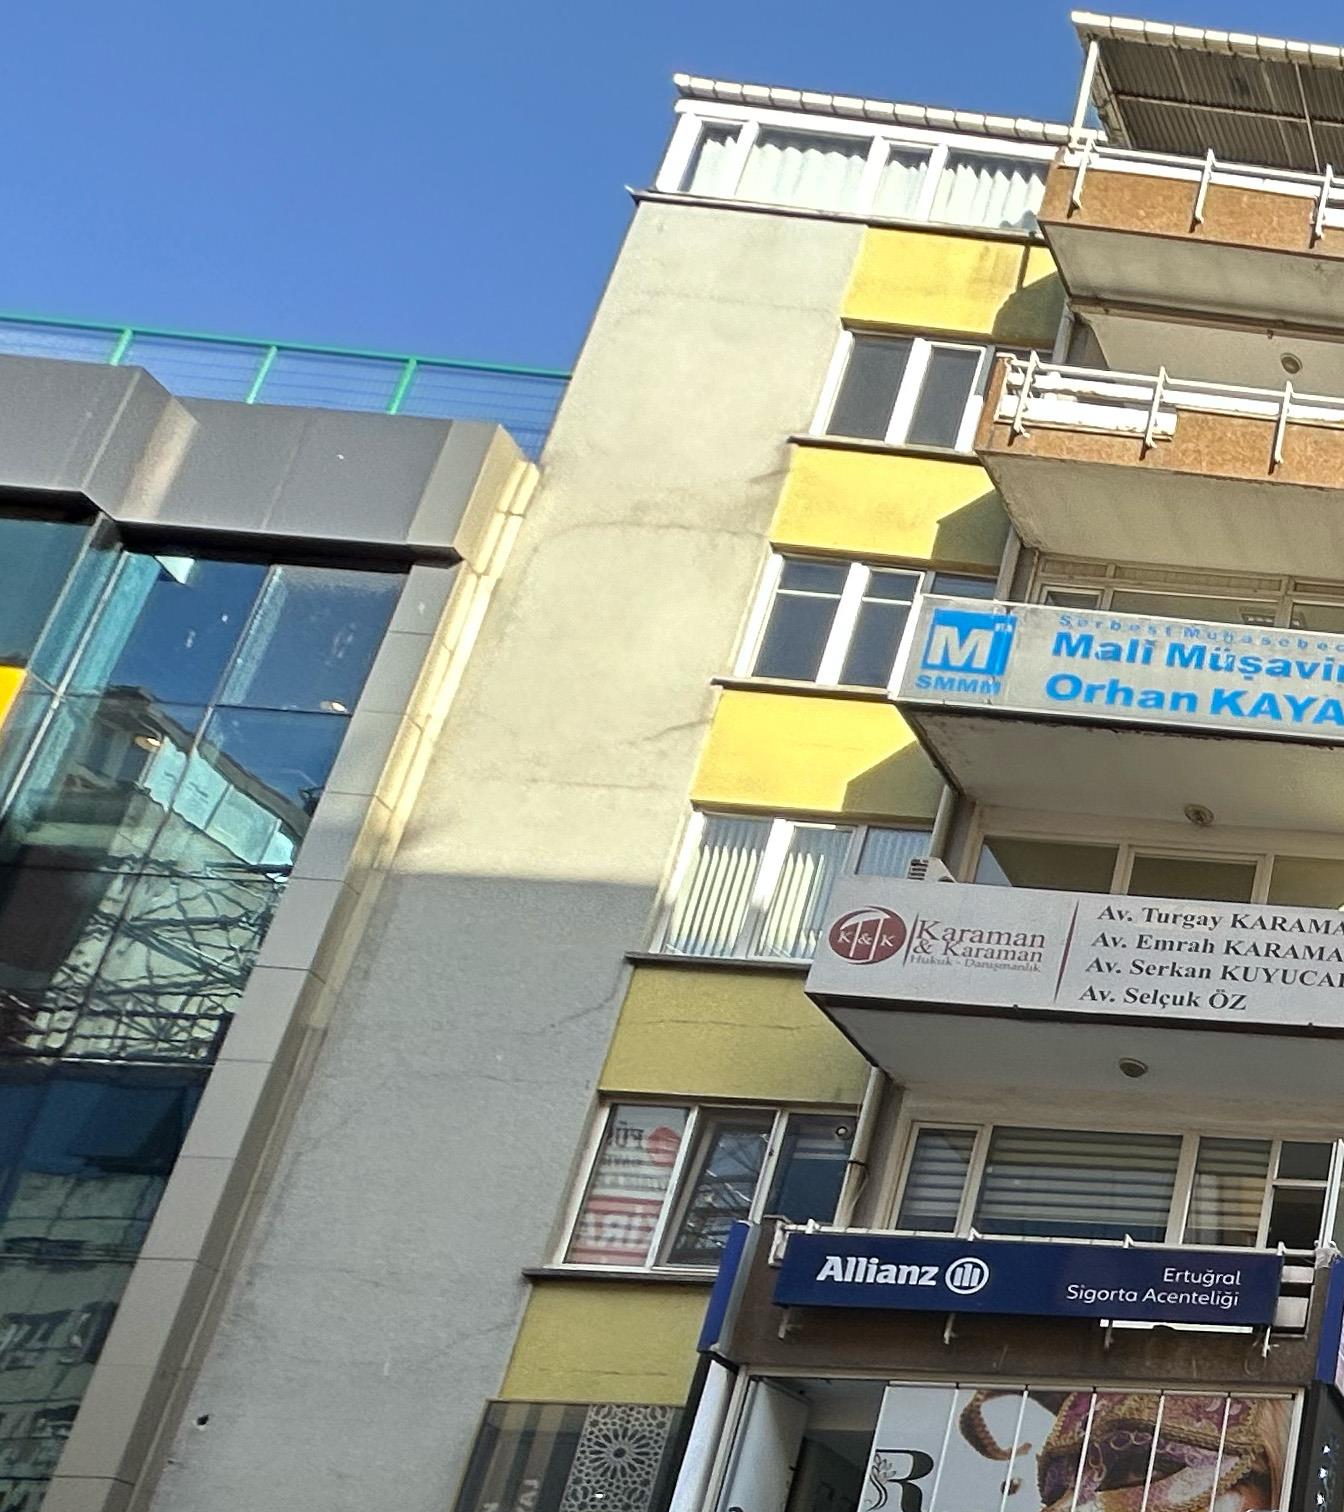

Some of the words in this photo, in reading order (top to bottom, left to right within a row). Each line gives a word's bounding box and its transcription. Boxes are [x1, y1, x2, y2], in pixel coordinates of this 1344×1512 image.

[915, 675, 1001, 696] SMMM
[1045, 673, 1198, 714] Orhan
[1097, 905, 1133, 923] Av.
[1142, 907, 1223, 931] Turgay
[916, 920, 1046, 949] Karaman
[1091, 932, 1127, 949] Av.
[1136, 935, 1215, 955] Emrah
[943, 941, 1043, 964] Karaman
[1085, 957, 1121, 975] Av.
[1129, 959, 1212, 980] Serkan
[1079, 985, 1115, 1003] Av.
[1123, 988, 1200, 1010] Selçuk
[1208, 989, 1248, 1011] ÖZ
[816, 1256, 937, 1286] Allianz
[1066, 1284, 1138, 1304] Sigorta
[1142, 1287, 1240, 1308] Acenteliği
